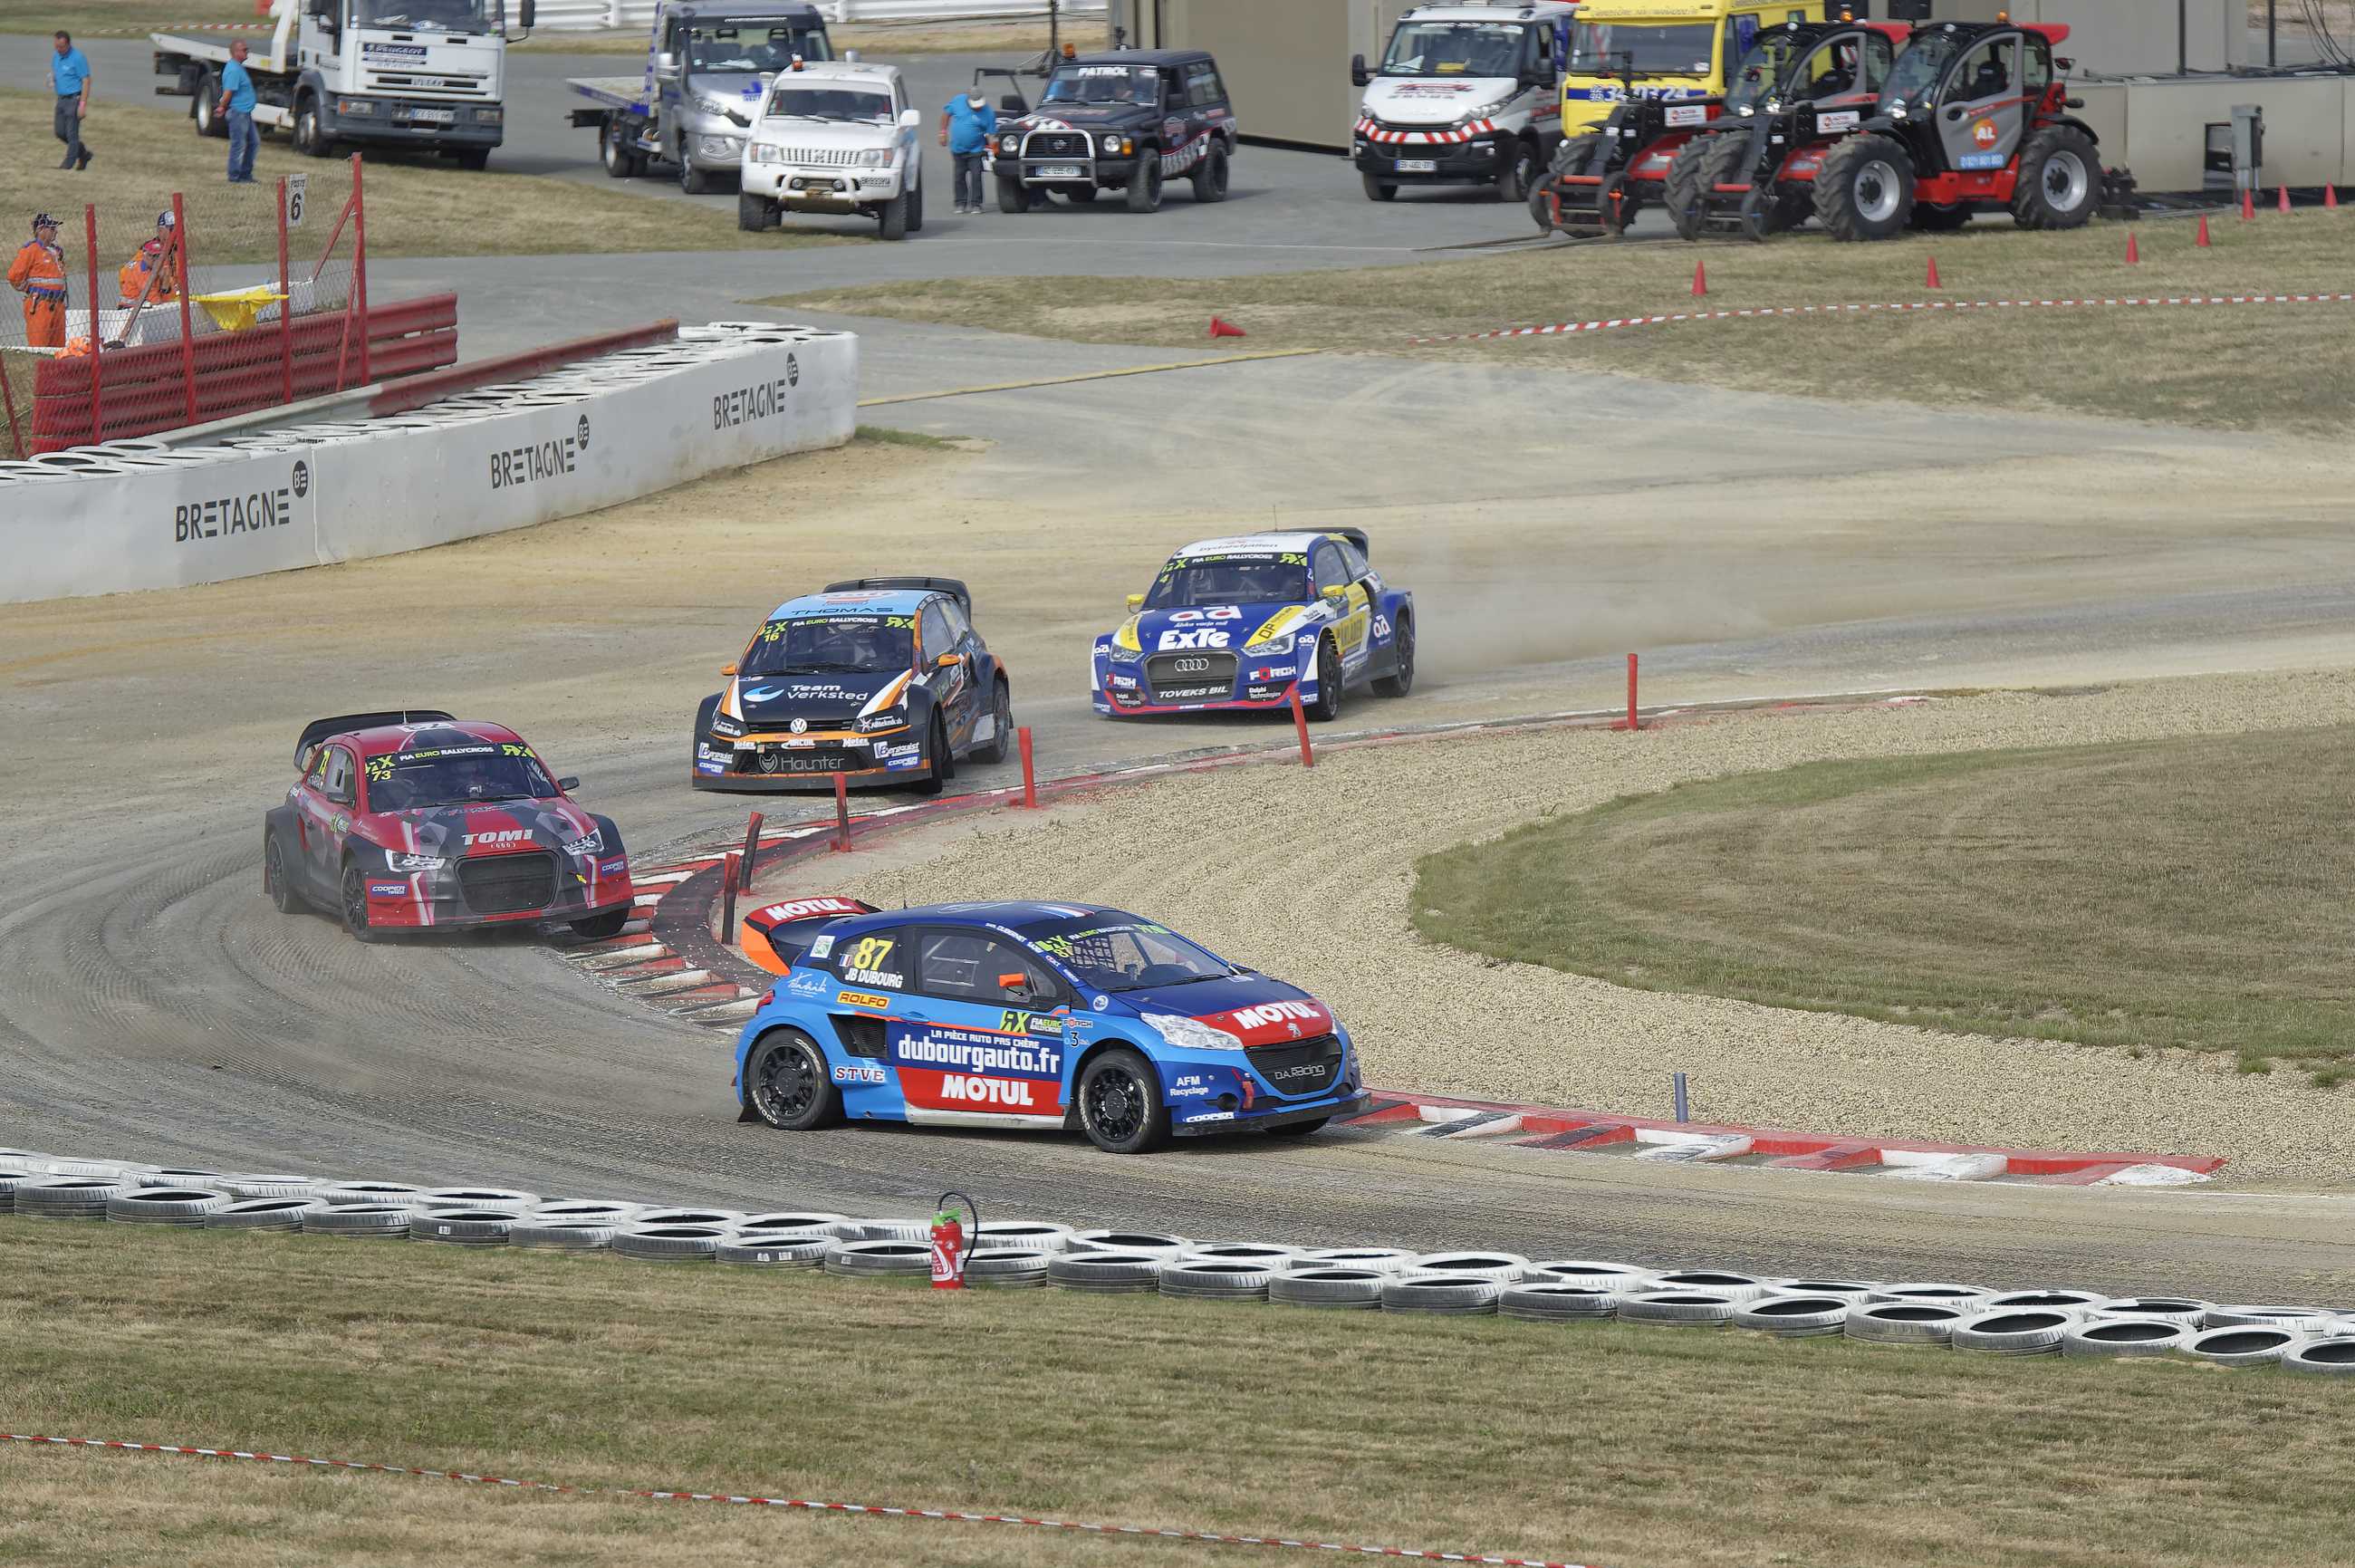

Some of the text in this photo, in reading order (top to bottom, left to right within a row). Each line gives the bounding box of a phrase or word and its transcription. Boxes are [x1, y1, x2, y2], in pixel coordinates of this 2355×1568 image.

[1078, 67, 1129, 77] PATROL
[1976, 126, 1995, 141] AL
[290, 193, 301, 221] 6
[713, 379, 785, 430] BRETAGNE
[491, 437, 575, 490] BRETAGNE
[176, 487, 290, 543] BRETAGNE
[1205, 554, 1226, 563] EURO
[1226, 553, 1274, 561] RALLYCROSS
[791, 607, 895, 616] THOMAS
[806, 618, 829, 626] EURO
[829, 616, 879, 624] RALLYCROSS
[1158, 628, 1231, 651] ExTe
[786, 690, 869, 700] Verksted
[790, 684, 841, 692] Team
[1159, 686, 1229, 698] TOVEKS BIL
[1248, 686, 1267, 694] Delphi
[399, 754, 415, 762] FIA
[415, 750, 440, 758] EURO
[440, 746, 495, 756] RALLYCROSS
[781, 755, 845, 771] Haunter
[371, 770, 392, 783] 73
[601, 861, 624, 871] COOPER
[371, 885, 407, 895] COOPER
[764, 898, 853, 921] MOTUL
[853, 937, 894, 971] 87
[844, 967, 904, 989] JB DUBOURG
[841, 993, 888, 1007] ROLFO
[1232, 1001, 1322, 1030] MOTUL
[930, 1029, 1040, 1050] LA PIÈCE AUTO PAS CHÈRE
[898, 1034, 1061, 1073] dubourgauto.fr
[835, 1066, 885, 1082] STVE
[1176, 1075, 1201, 1087] AFM
[940, 1073, 1034, 1107] MOTUL
[1169, 1085, 1210, 1098] Recyclage
